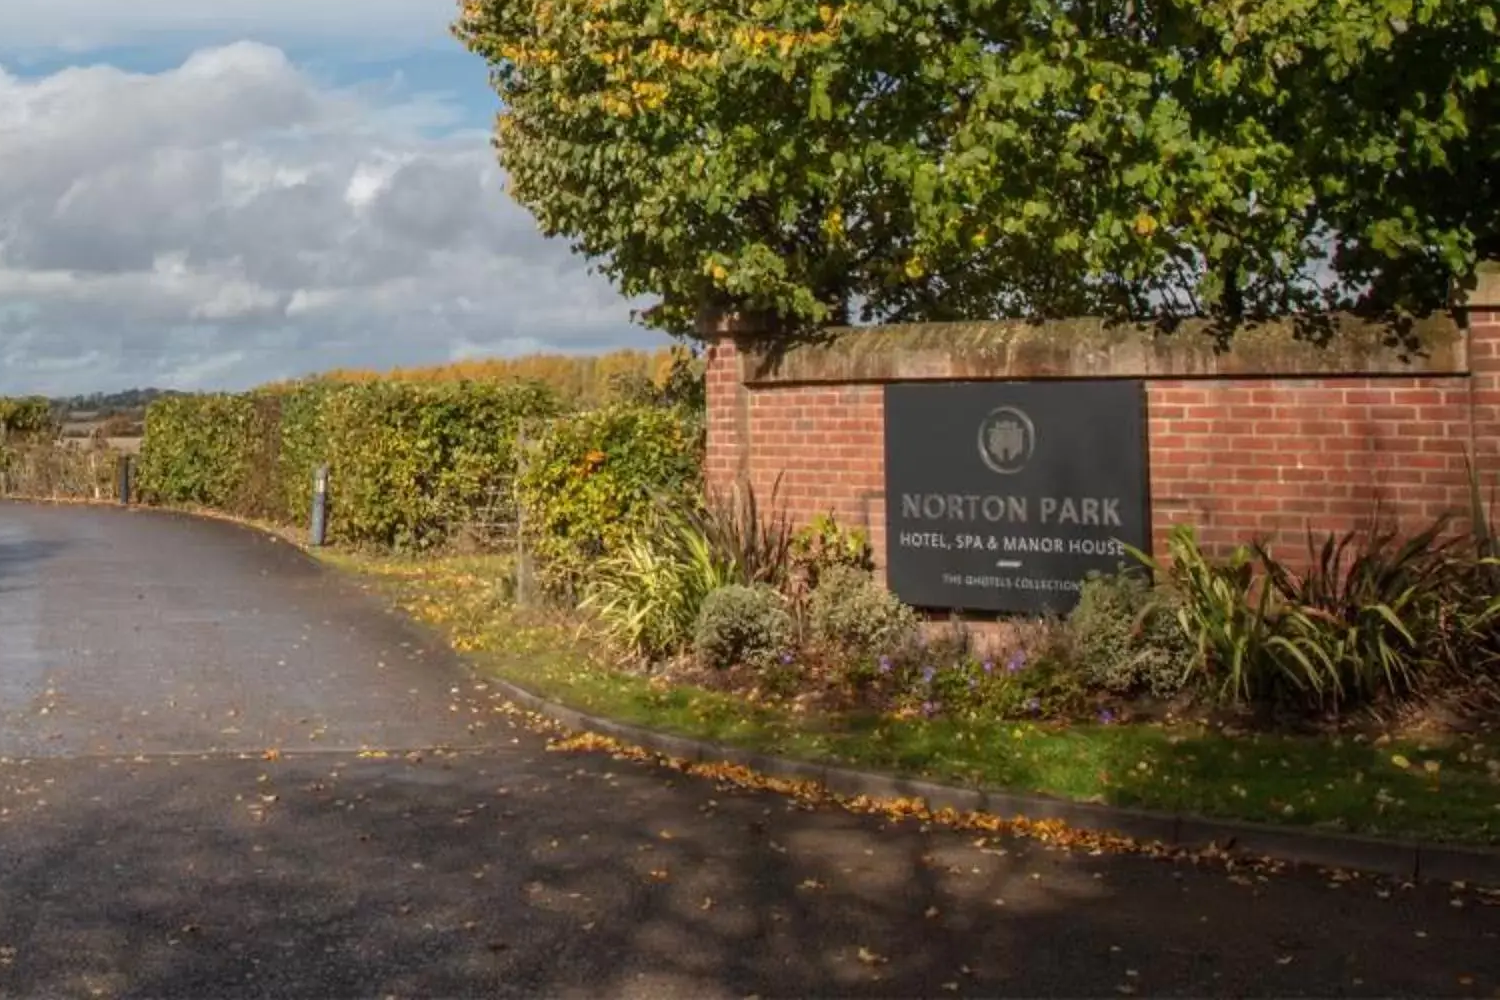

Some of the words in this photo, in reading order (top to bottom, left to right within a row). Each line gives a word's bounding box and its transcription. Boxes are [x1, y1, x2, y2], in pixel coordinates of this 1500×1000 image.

[901, 493, 1027, 522] NORTON
[1040, 497, 1122, 526] PARK
[900, 532, 951, 550] HOTEL,
[955, 535, 983, 549] SPA
[987, 536, 998, 550] &
[1003, 536, 1063, 552] MANOR
[1069, 539, 1125, 556] HOUSE
